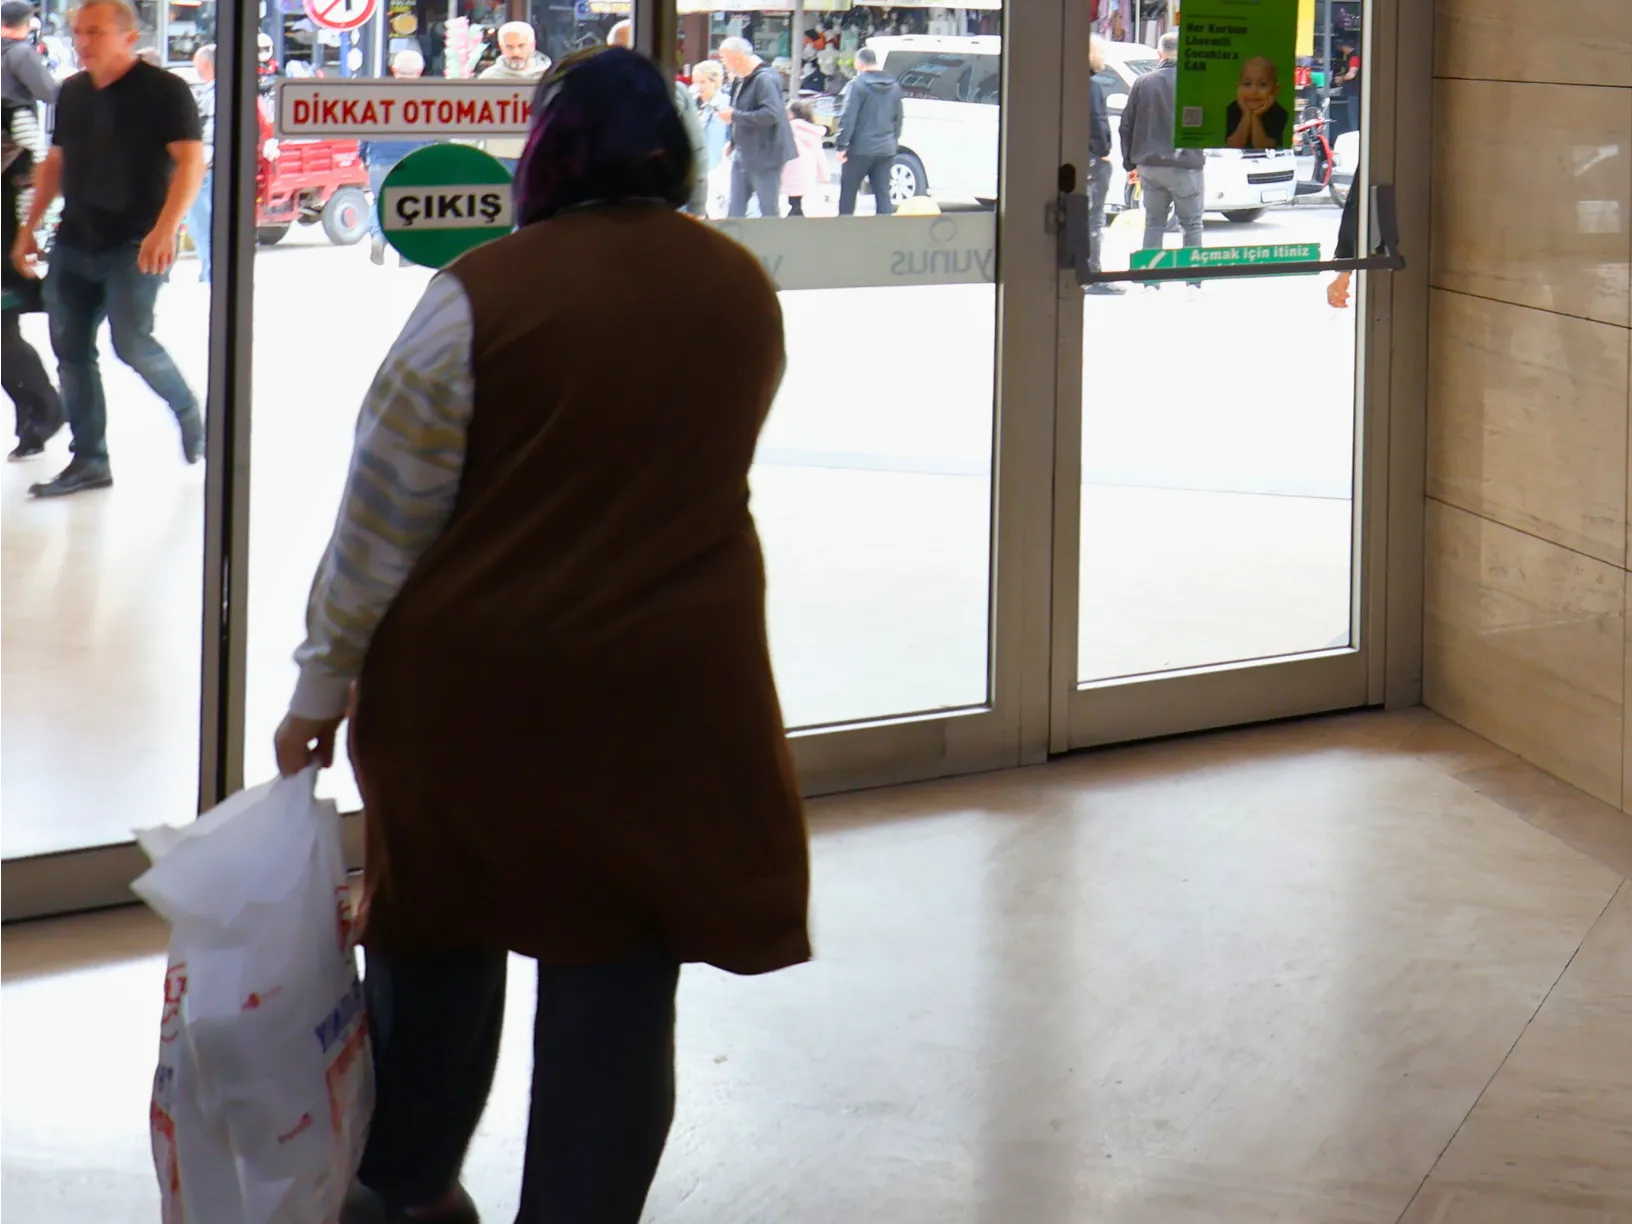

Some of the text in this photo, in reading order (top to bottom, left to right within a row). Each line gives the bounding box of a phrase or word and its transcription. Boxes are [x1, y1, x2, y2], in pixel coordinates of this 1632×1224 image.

[294, 92, 395, 124] DİKKAT
[396, 193, 502, 226] ÇIKIŞ
[1190, 249, 1239, 262] Açmak
[1243, 247, 1270, 262] için
[1273, 245, 1310, 258] itiniz
